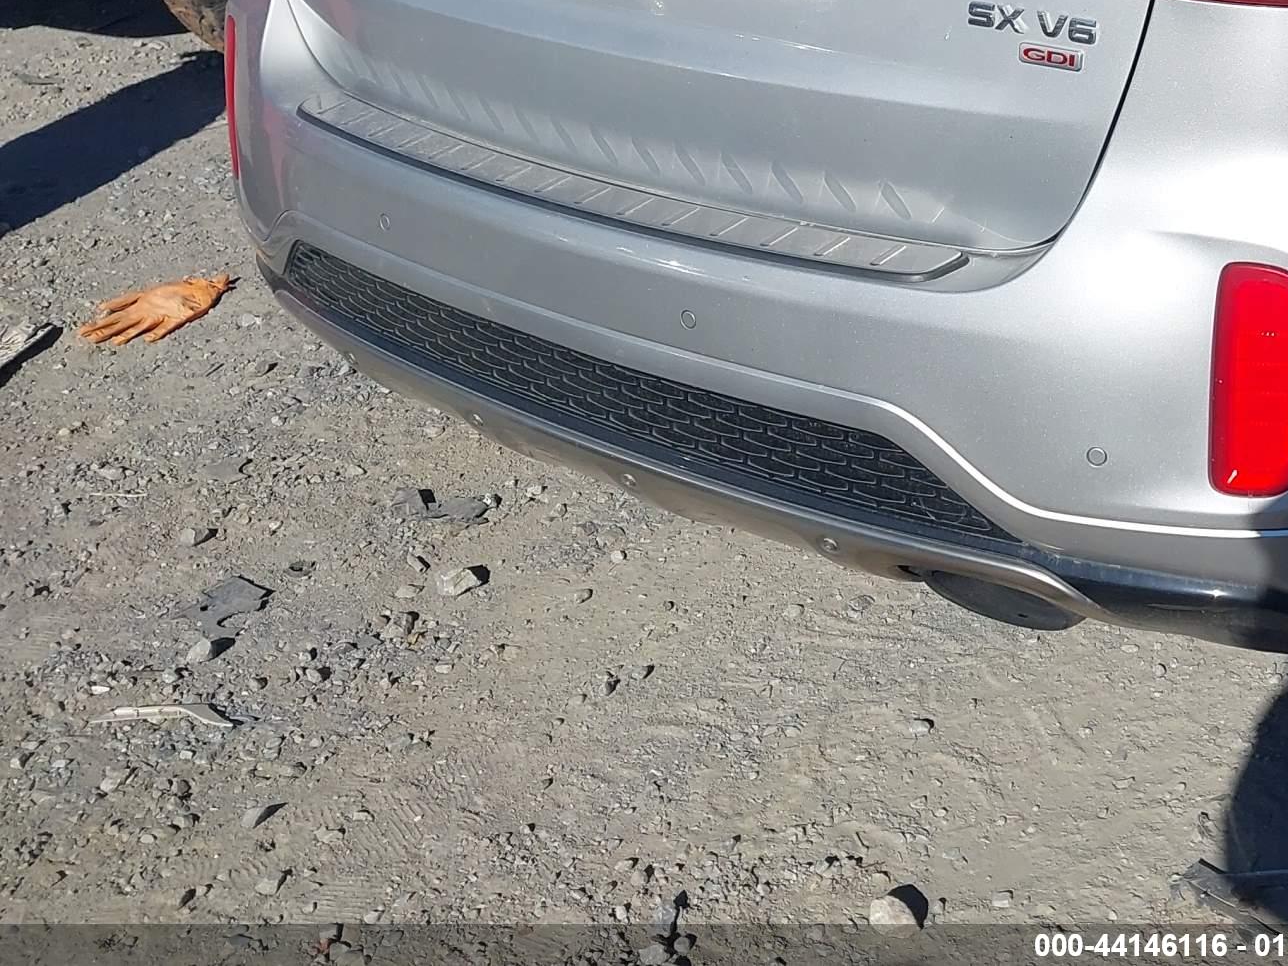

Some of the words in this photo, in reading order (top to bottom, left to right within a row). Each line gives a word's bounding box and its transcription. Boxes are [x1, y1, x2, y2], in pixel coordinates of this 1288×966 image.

[967, 0, 1027, 35] SX
[1037, 10, 1098, 45] V6
[1023, 47, 1076, 67] GDI
